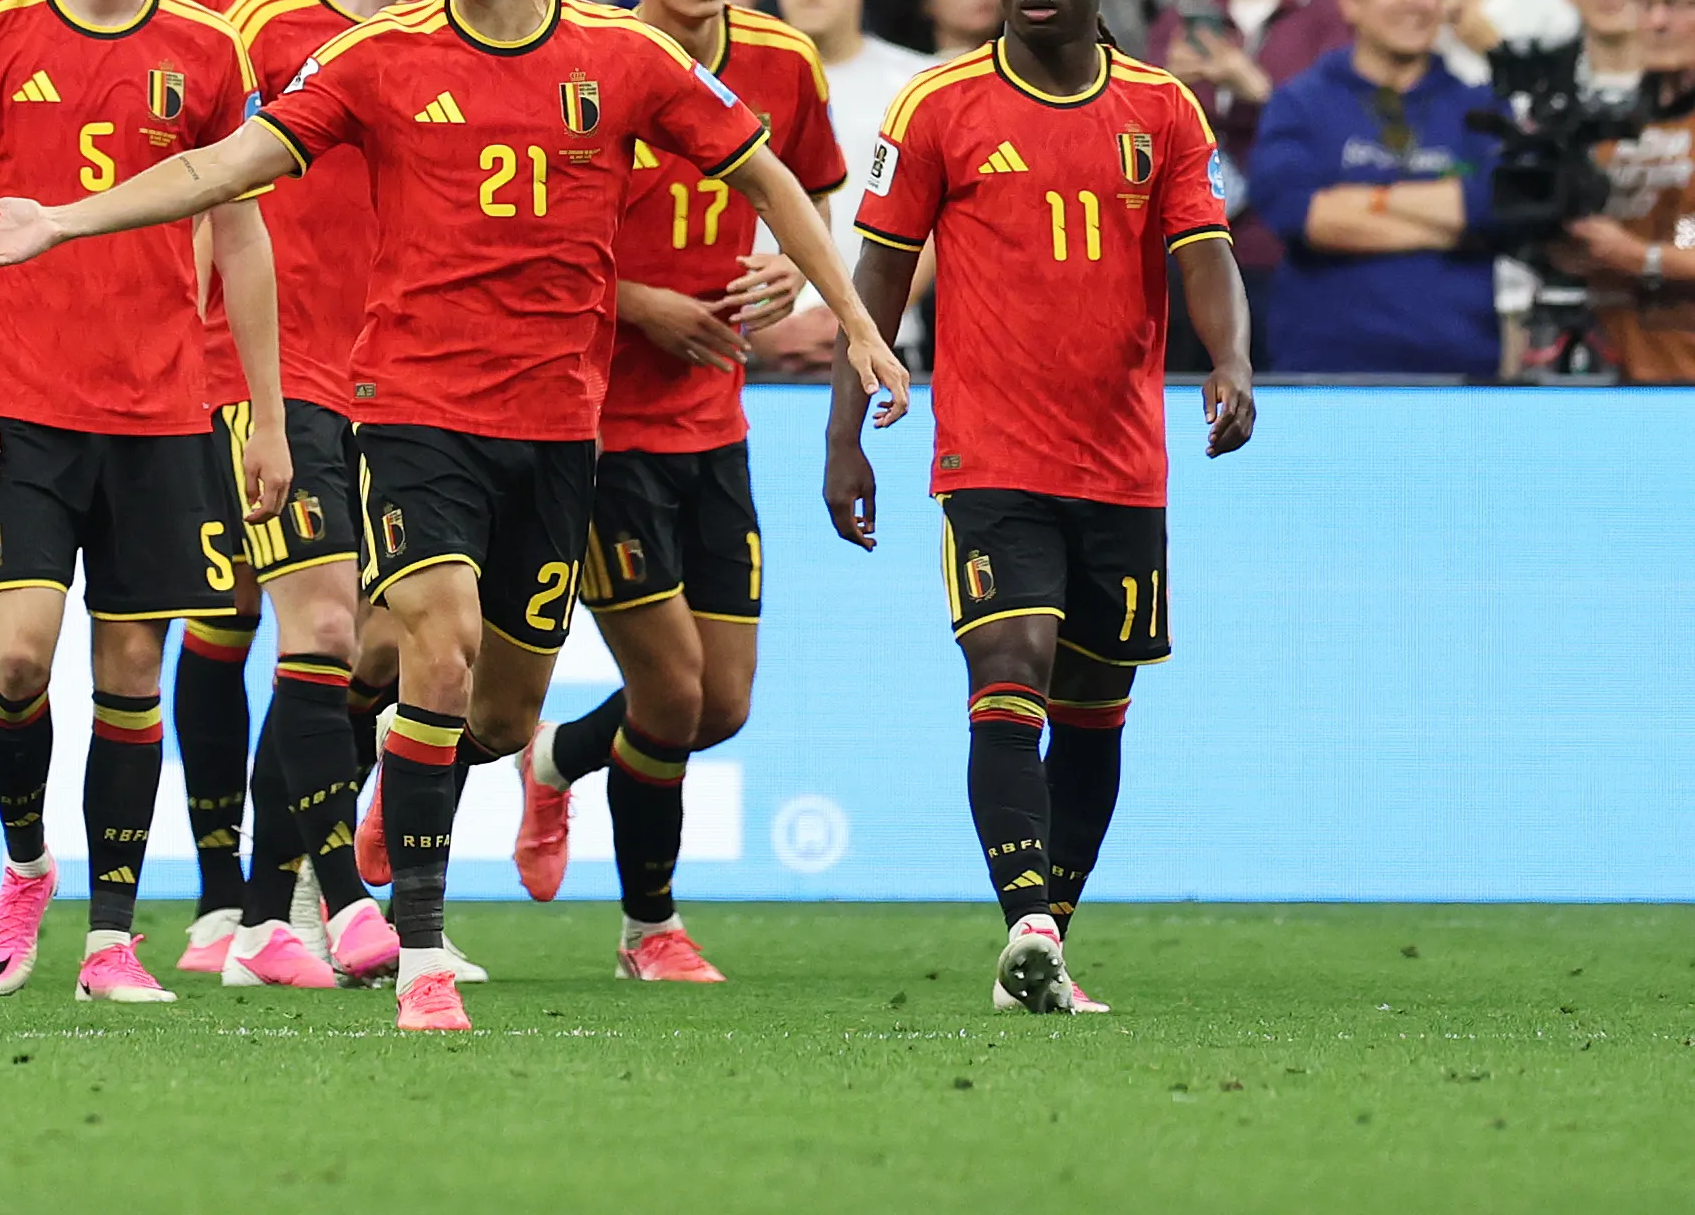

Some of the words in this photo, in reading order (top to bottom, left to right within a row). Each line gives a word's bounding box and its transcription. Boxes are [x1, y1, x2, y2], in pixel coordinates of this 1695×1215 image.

[78, 121, 116, 193] 5
[478, 144, 548, 217] 21
[670, 180, 729, 250] 17
[1045, 190, 1101, 262] 11
[200, 521, 235, 592] 5
[525, 560, 580, 632] 21
[1118, 568, 1160, 642] 11
[403, 833, 450, 848] RBFA
[987, 839, 1043, 859] RBFA
